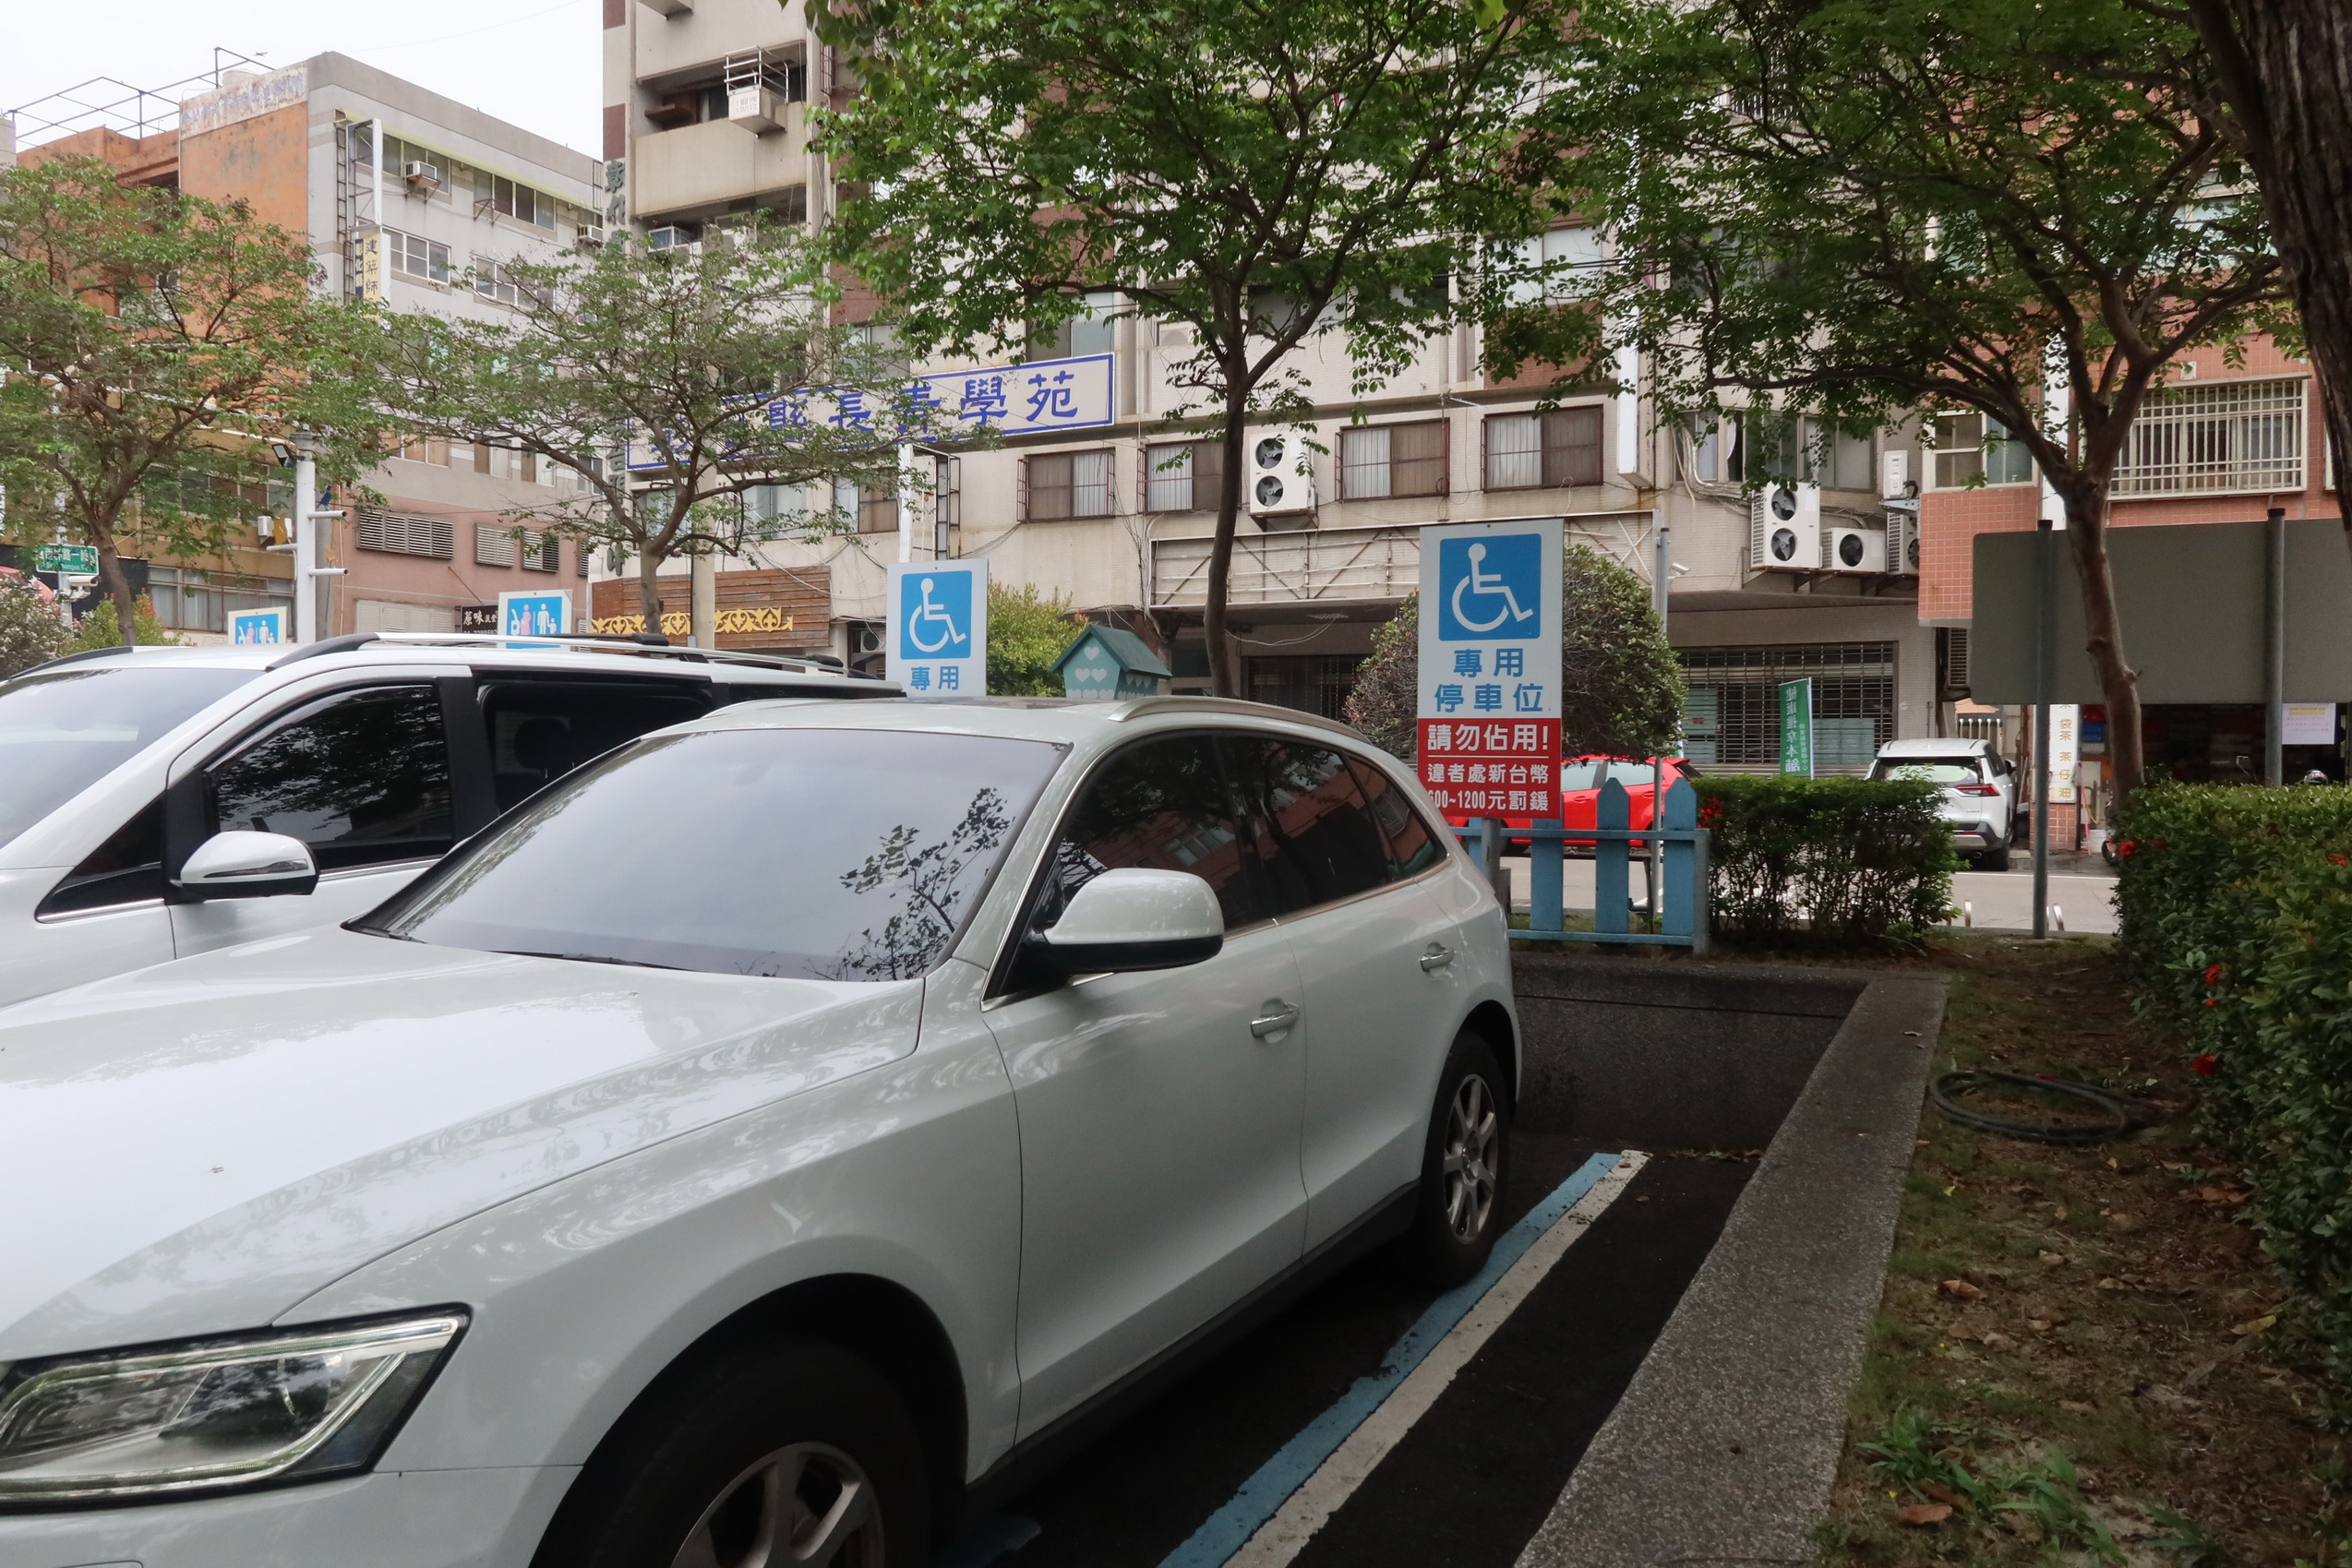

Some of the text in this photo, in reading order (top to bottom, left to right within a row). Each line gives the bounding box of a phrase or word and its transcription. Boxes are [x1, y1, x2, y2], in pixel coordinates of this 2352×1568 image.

[1453, 648, 1524, 678] 專用
[910, 665, 959, 690] 專用
[1434, 683, 1544, 713] 停車位
[1427, 724, 1549, 752] 請勿佔用!
[1427, 763, 1550, 784] 違者處新台幣
